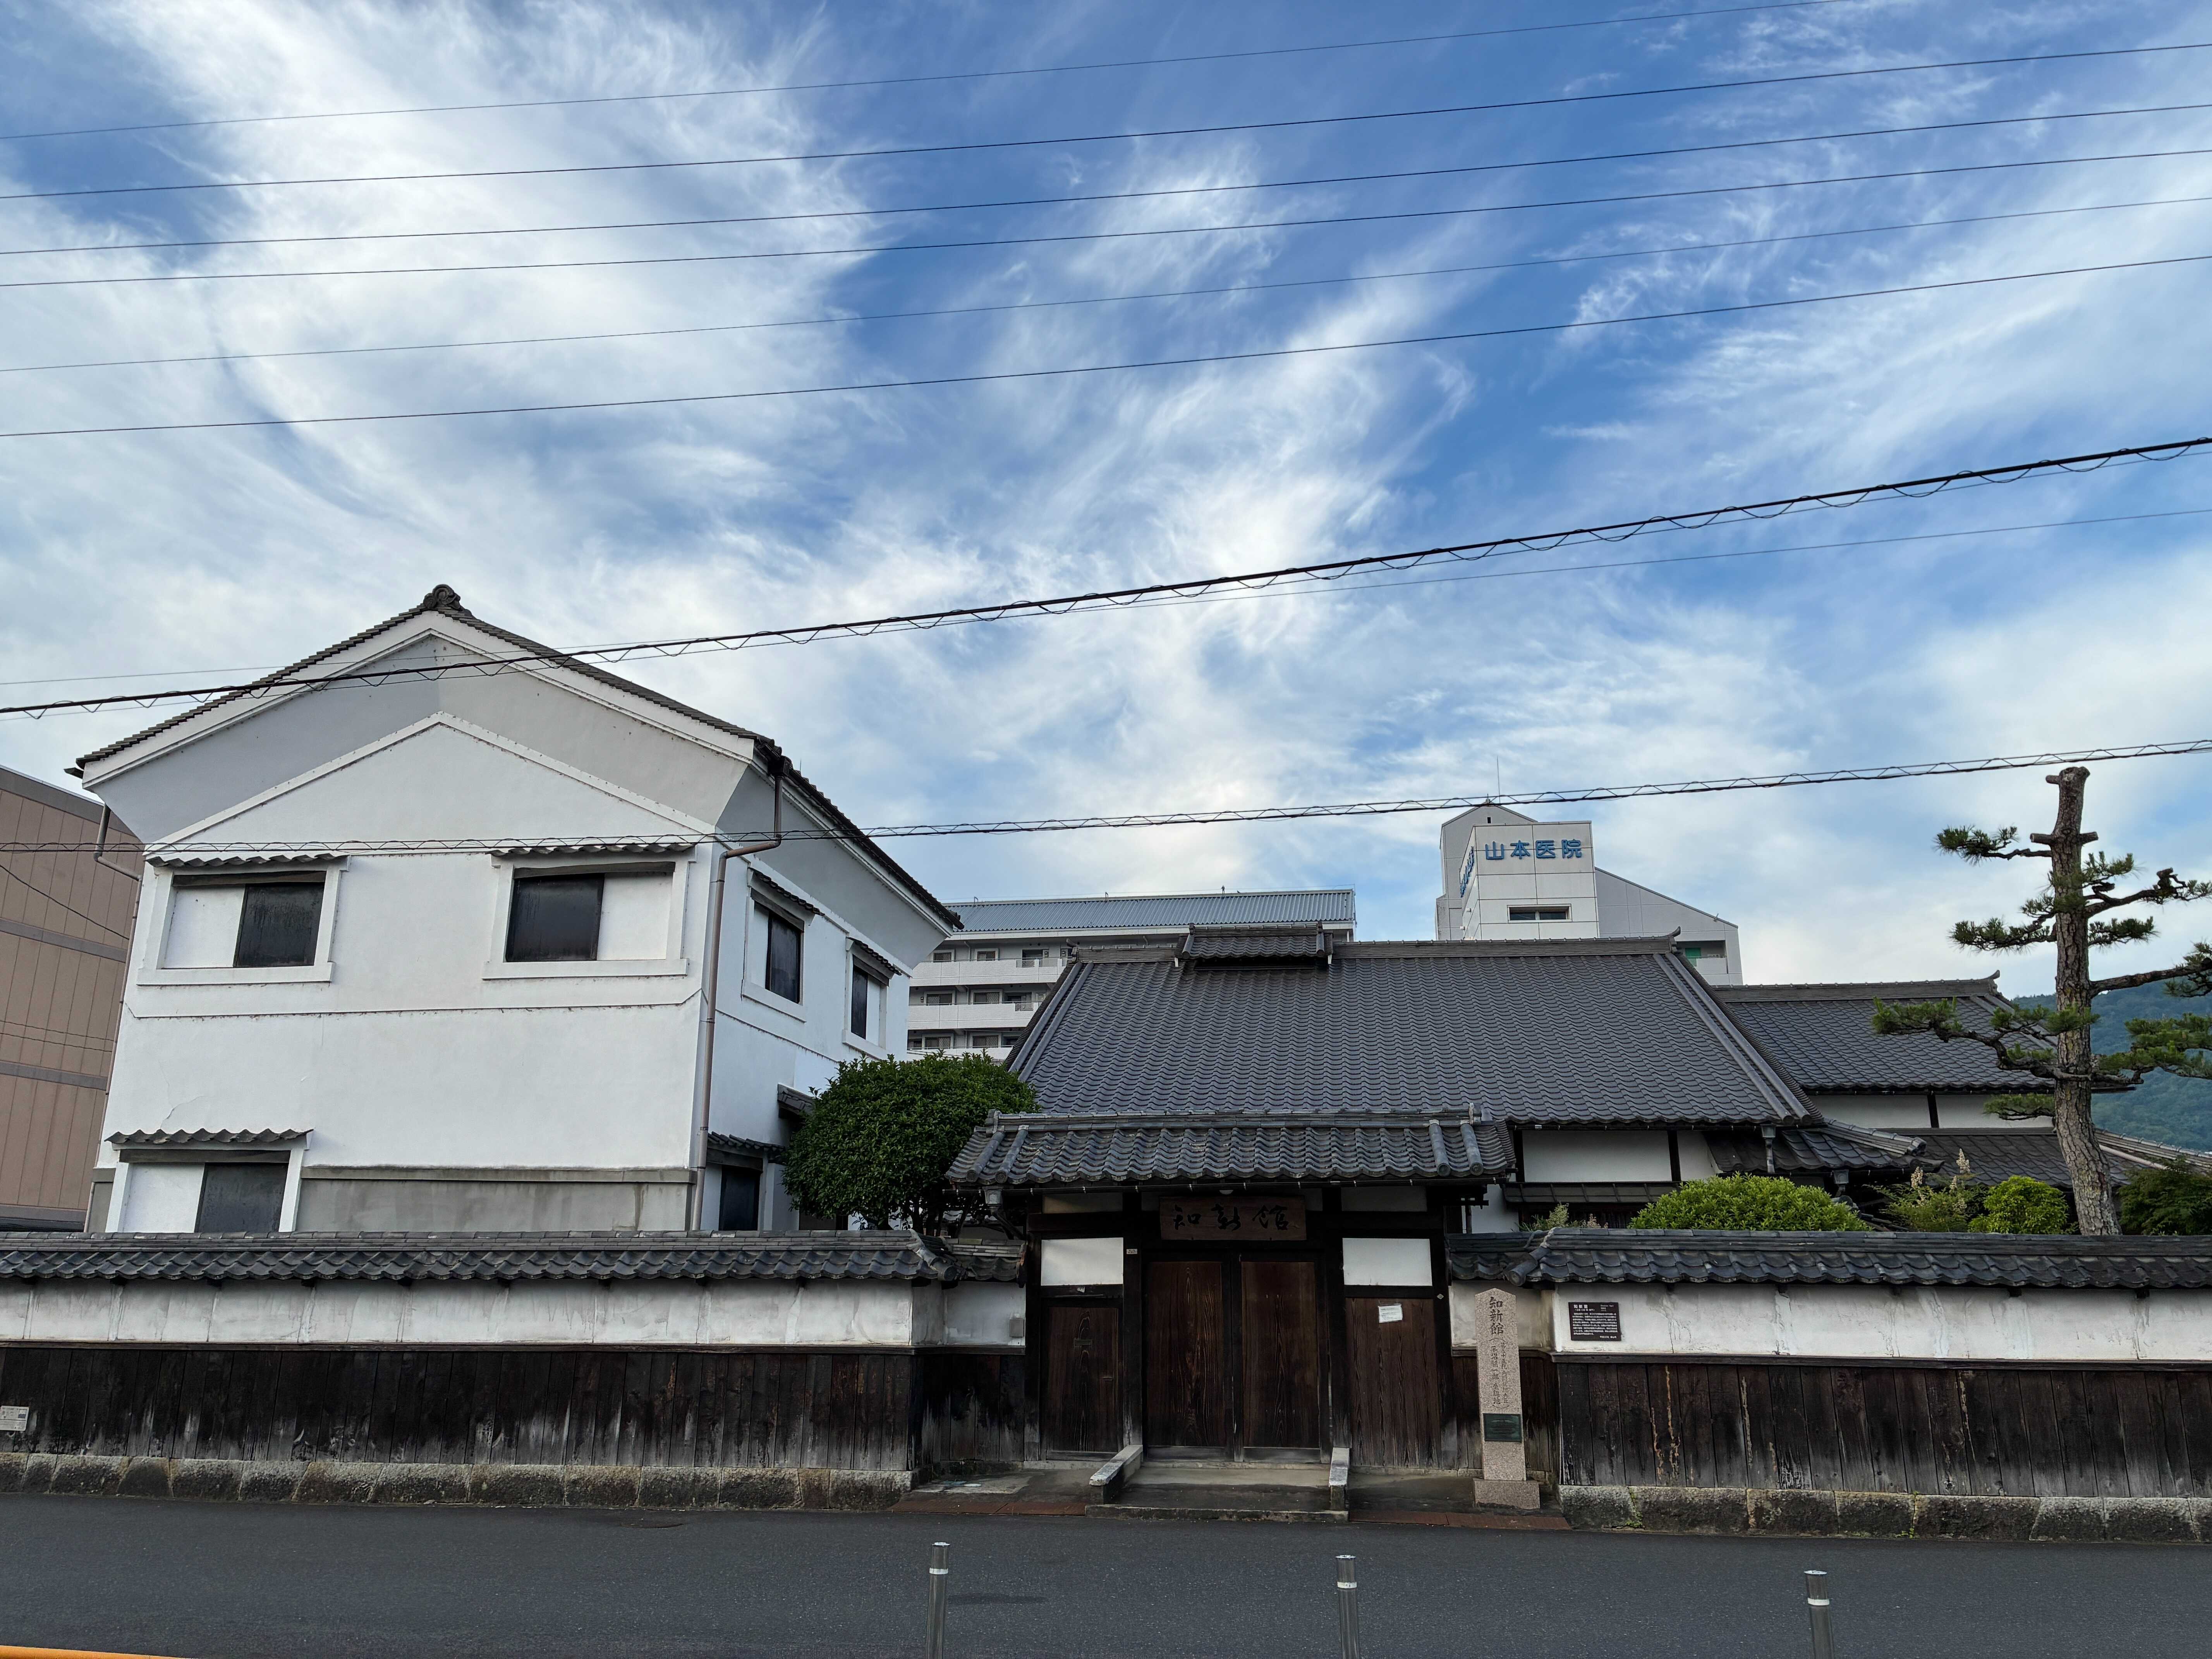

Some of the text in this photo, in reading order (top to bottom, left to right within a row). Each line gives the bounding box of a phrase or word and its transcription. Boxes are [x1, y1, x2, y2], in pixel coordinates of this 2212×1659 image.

[1485, 839, 1582, 860] 山本医院
[1489, 1296, 1504, 1335] 知新館
